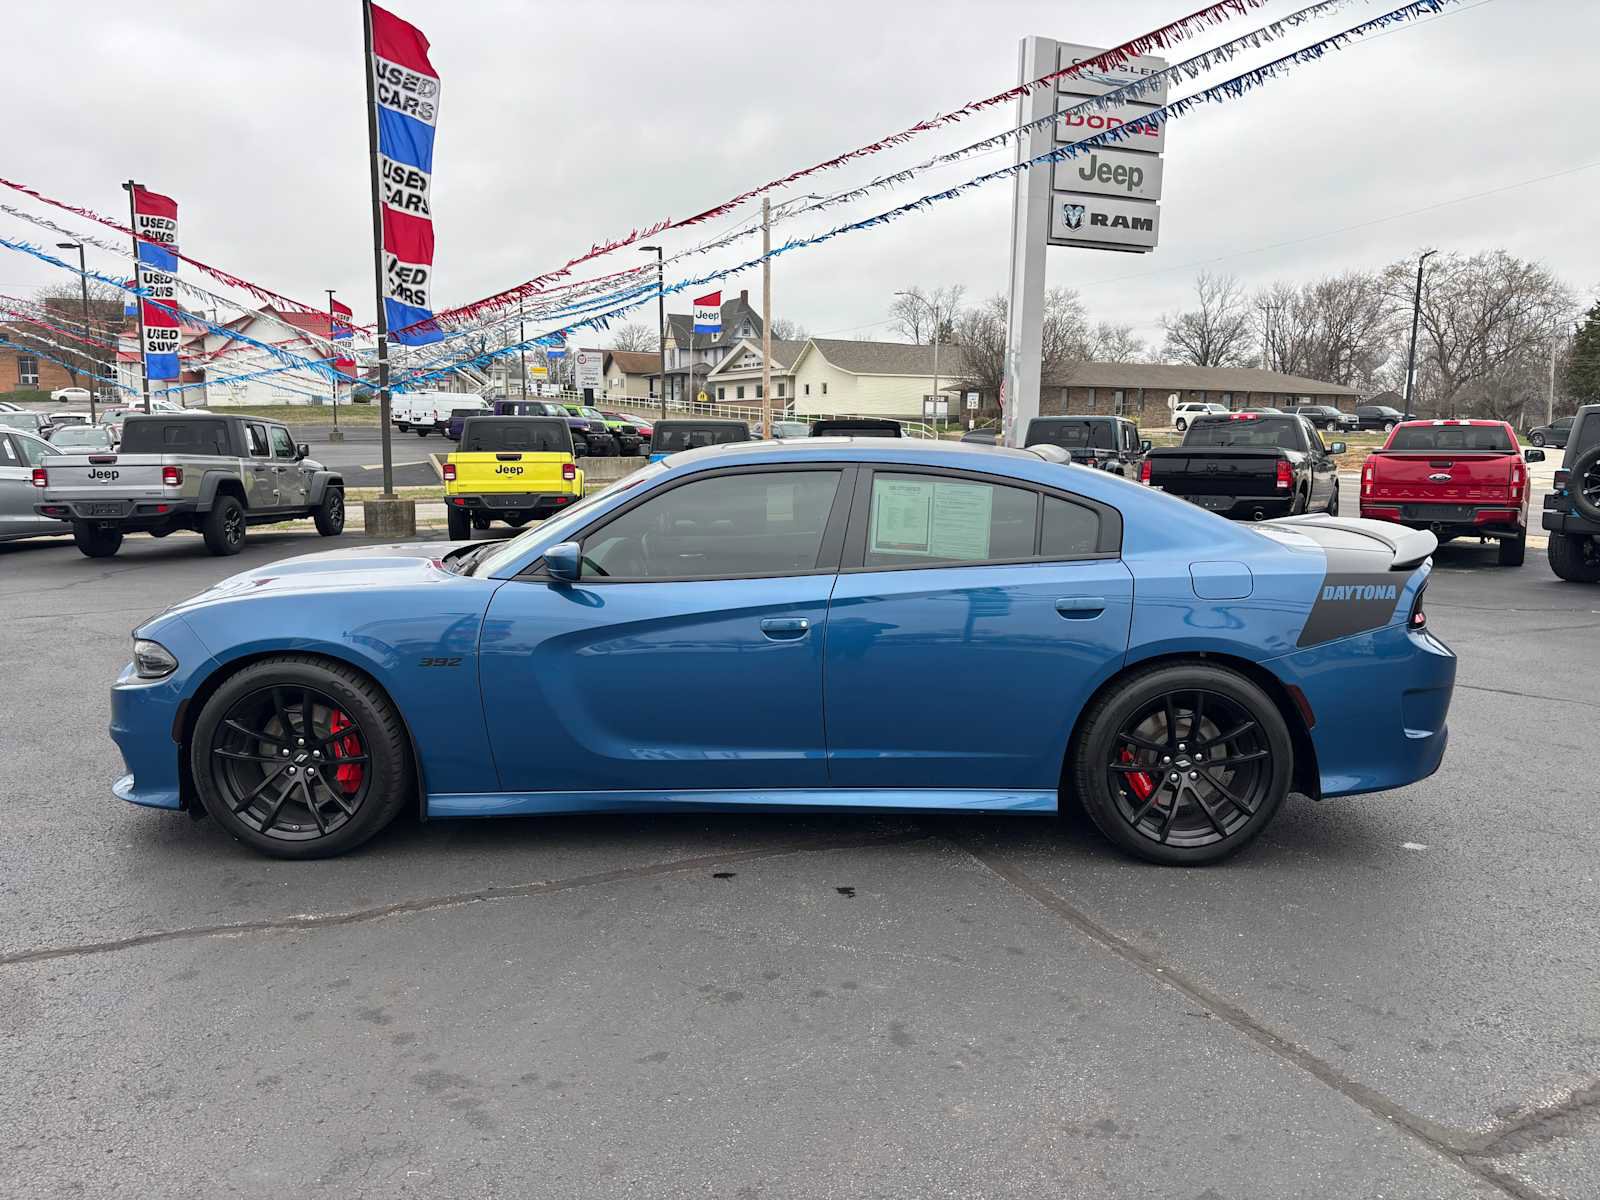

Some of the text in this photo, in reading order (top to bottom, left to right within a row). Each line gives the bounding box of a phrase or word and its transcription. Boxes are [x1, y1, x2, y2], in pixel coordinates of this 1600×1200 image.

[376, 59, 437, 98] USED
[378, 83, 435, 120] CARS
[1079, 154, 1144, 192] Jeep
[140, 216, 176, 231] USED
[1090, 213, 1153, 231] RAM
[144, 272, 174, 284] USED
[695, 310, 720, 321] Jeep
[147, 328, 178, 340] USED
[88, 468, 119, 481] Jeep
[495, 464, 524, 475] Jeep
[1322, 585, 1397, 601] DAYTONA
[418, 656, 463, 668] 392
